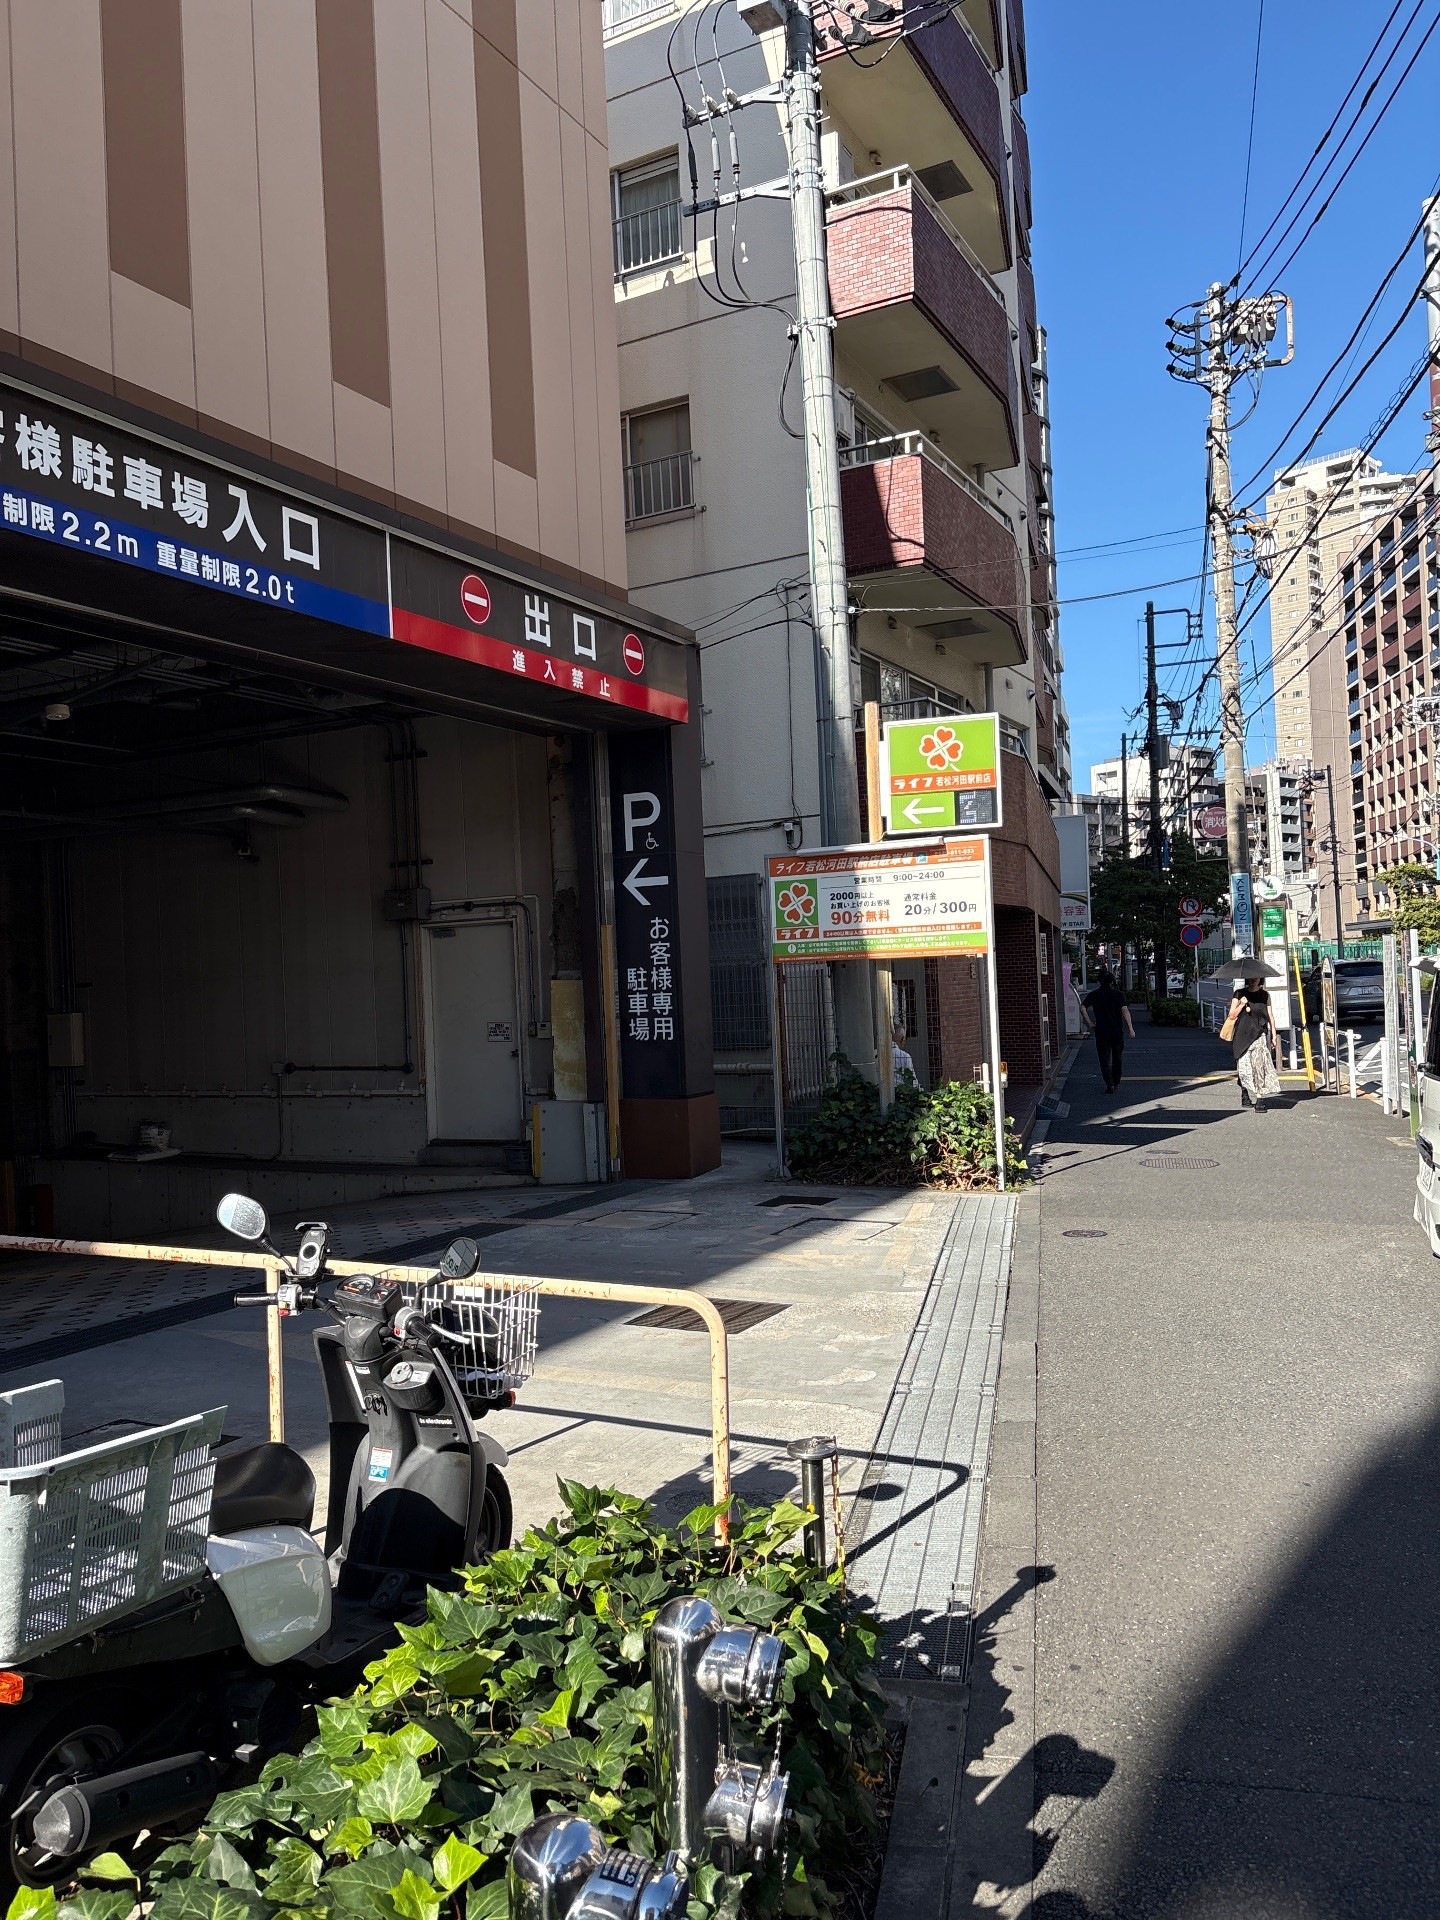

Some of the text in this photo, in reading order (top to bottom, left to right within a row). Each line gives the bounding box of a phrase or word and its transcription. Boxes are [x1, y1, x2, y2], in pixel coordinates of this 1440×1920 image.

[0, 409, 321, 570] 様駐車場入口
[3, 492, 295, 604] 制限2.2m 重量制限2.0t
[524, 594, 597, 661] 出口
[512, 649, 611, 698] 進入禁止
[893, 772, 992, 790] ライフ 若松河田駅前店
[623, 791, 661, 852] P
[830, 891, 875, 901] 2000円以上
[830, 898, 891, 910] お買い上げのお客様
[830, 909, 890, 925] 90分無料
[903, 892, 937, 902] 通常料金
[1236, 878, 1248, 921] KUMON
[781, 928, 815, 940] ライフ
[649, 916, 674, 1041] お客様専用
[627, 966, 650, 1042] 駐車場
